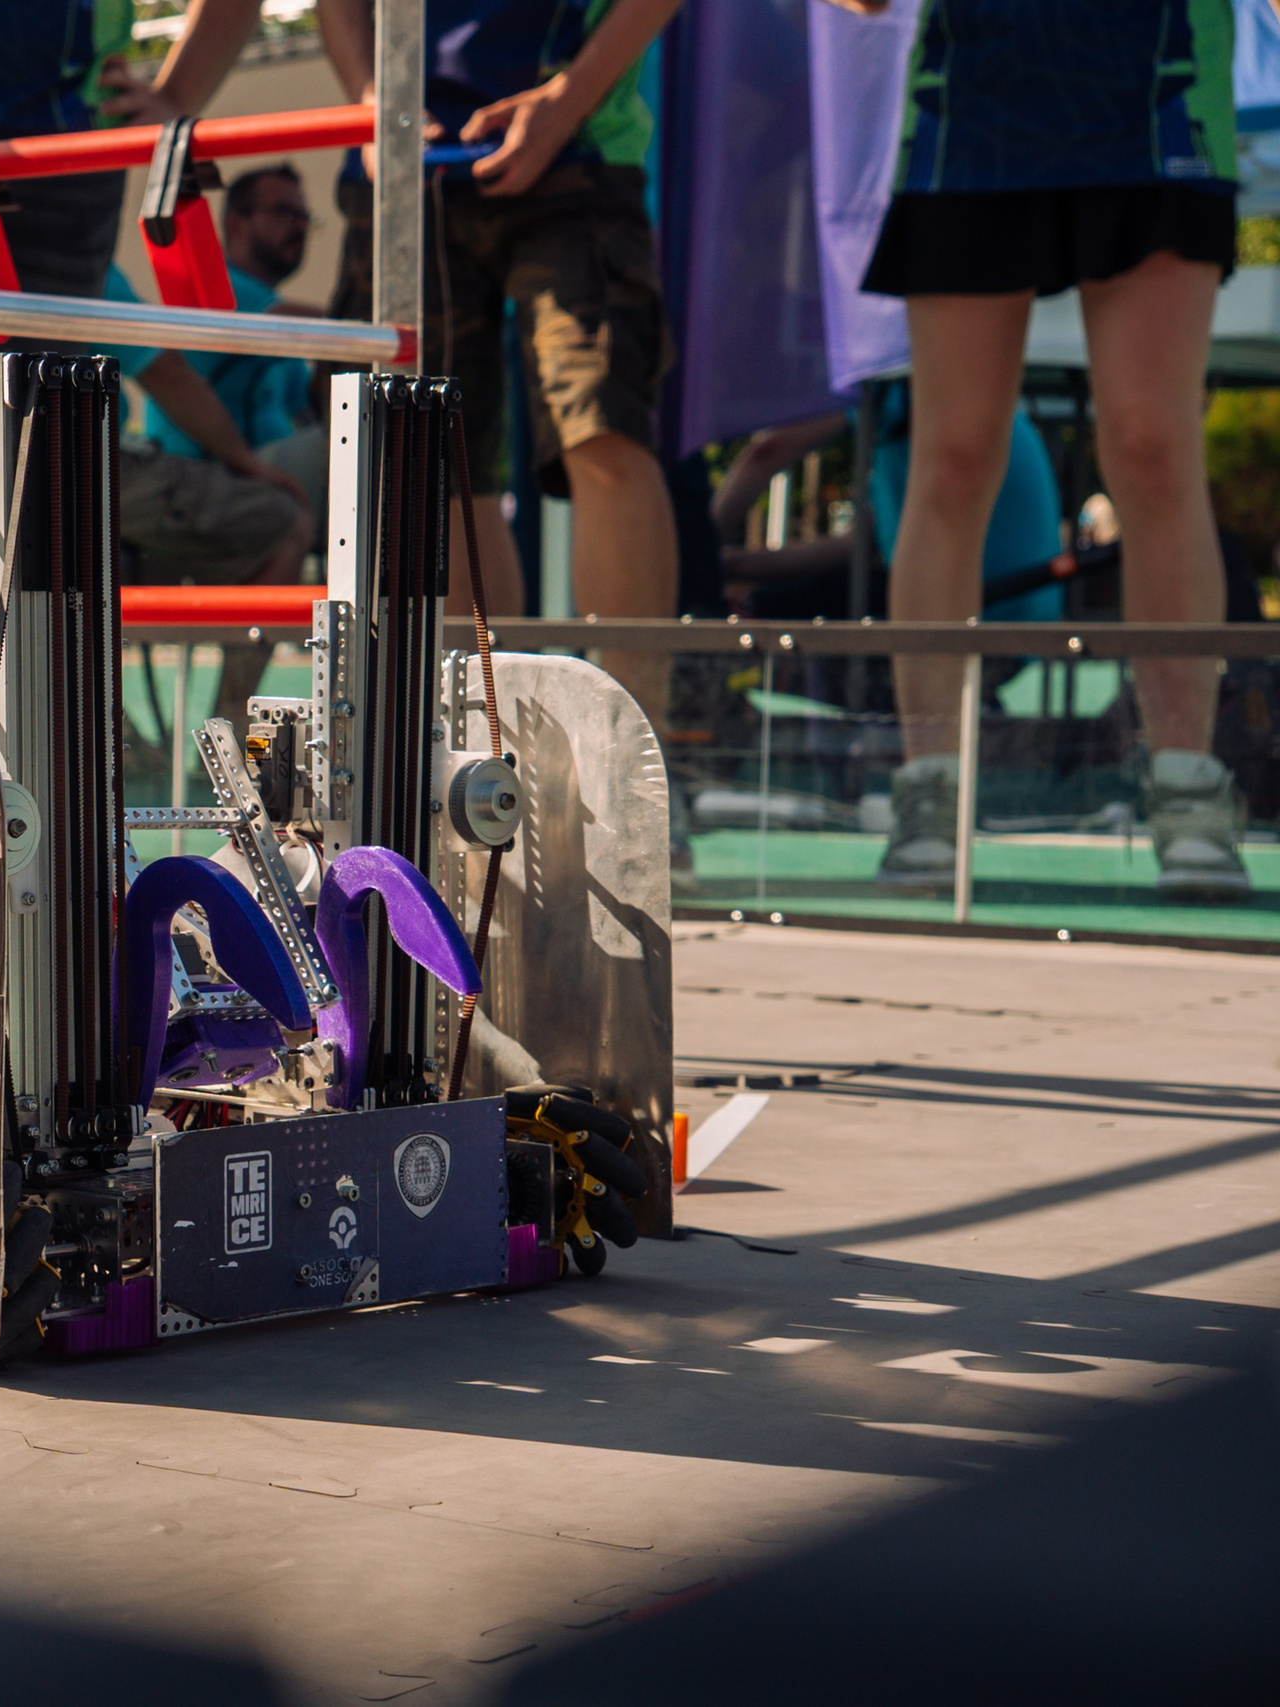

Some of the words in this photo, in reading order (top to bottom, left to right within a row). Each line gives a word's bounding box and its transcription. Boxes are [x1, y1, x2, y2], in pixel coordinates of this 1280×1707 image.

[228, 1159, 266, 1194] TE
[231, 1192, 265, 1217] MIRI
[231, 1215, 265, 1245] CE
[309, 1273, 333, 1288] ONE
